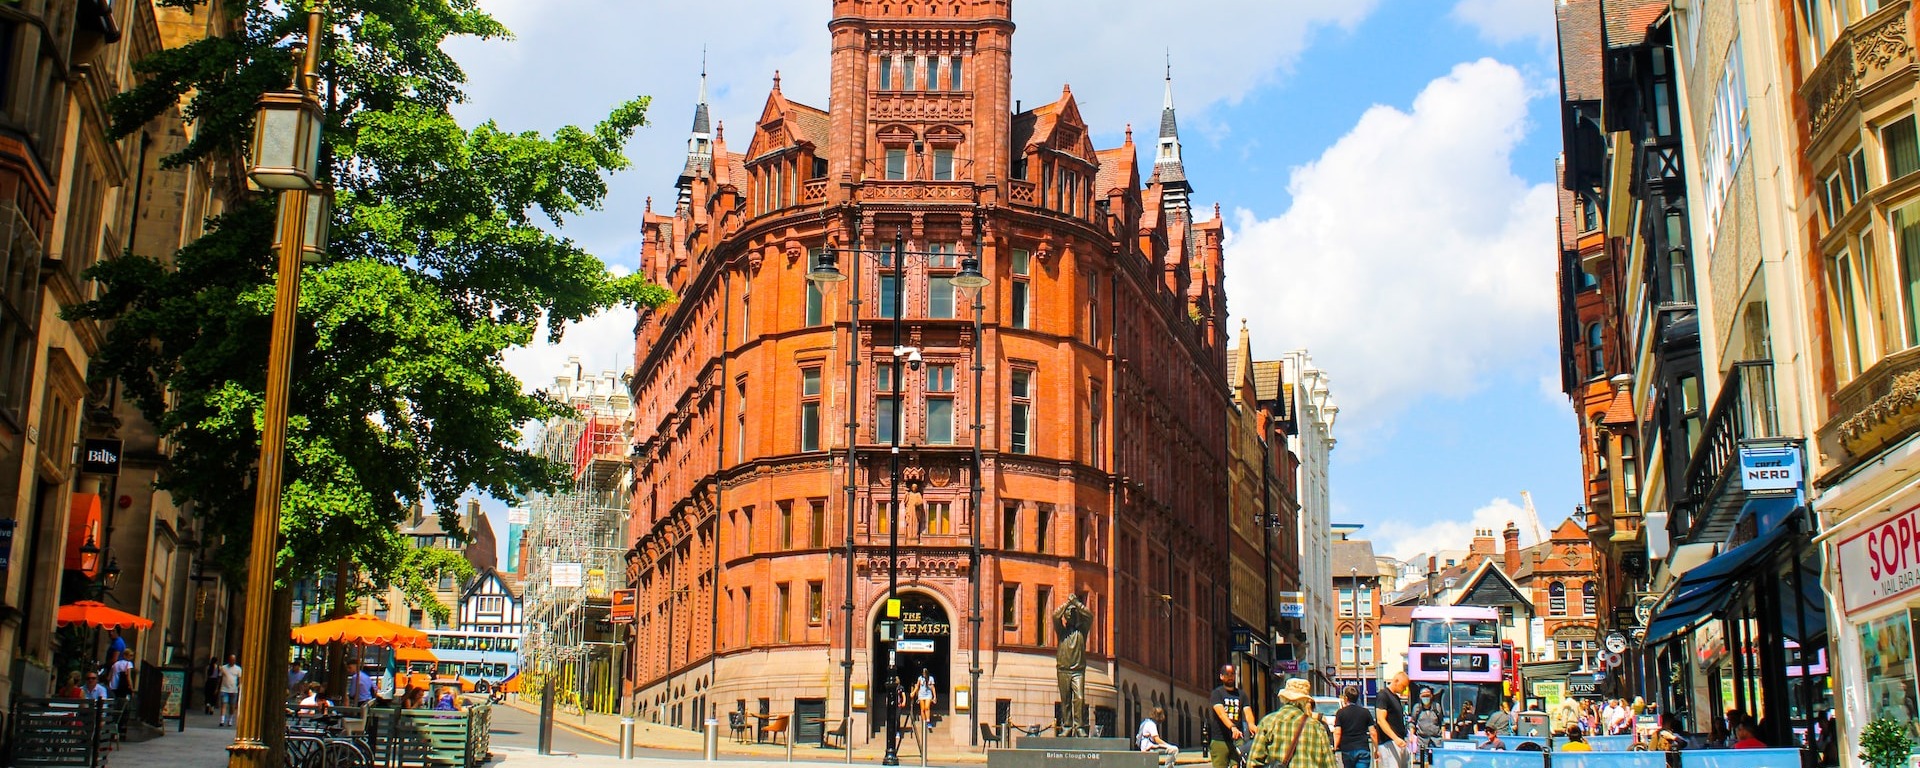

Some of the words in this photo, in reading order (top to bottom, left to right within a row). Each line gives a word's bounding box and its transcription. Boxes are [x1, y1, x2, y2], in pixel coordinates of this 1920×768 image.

[88, 449, 117, 464] Bill's
[1749, 470, 1789, 479] NERO
[1881, 578, 1898, 596] NAIL
[1898, 571, 1914, 590] BAR
[903, 612, 921, 620] THE
[1472, 656, 1482, 666] 27
[1064, 752, 1086, 760] Clough
